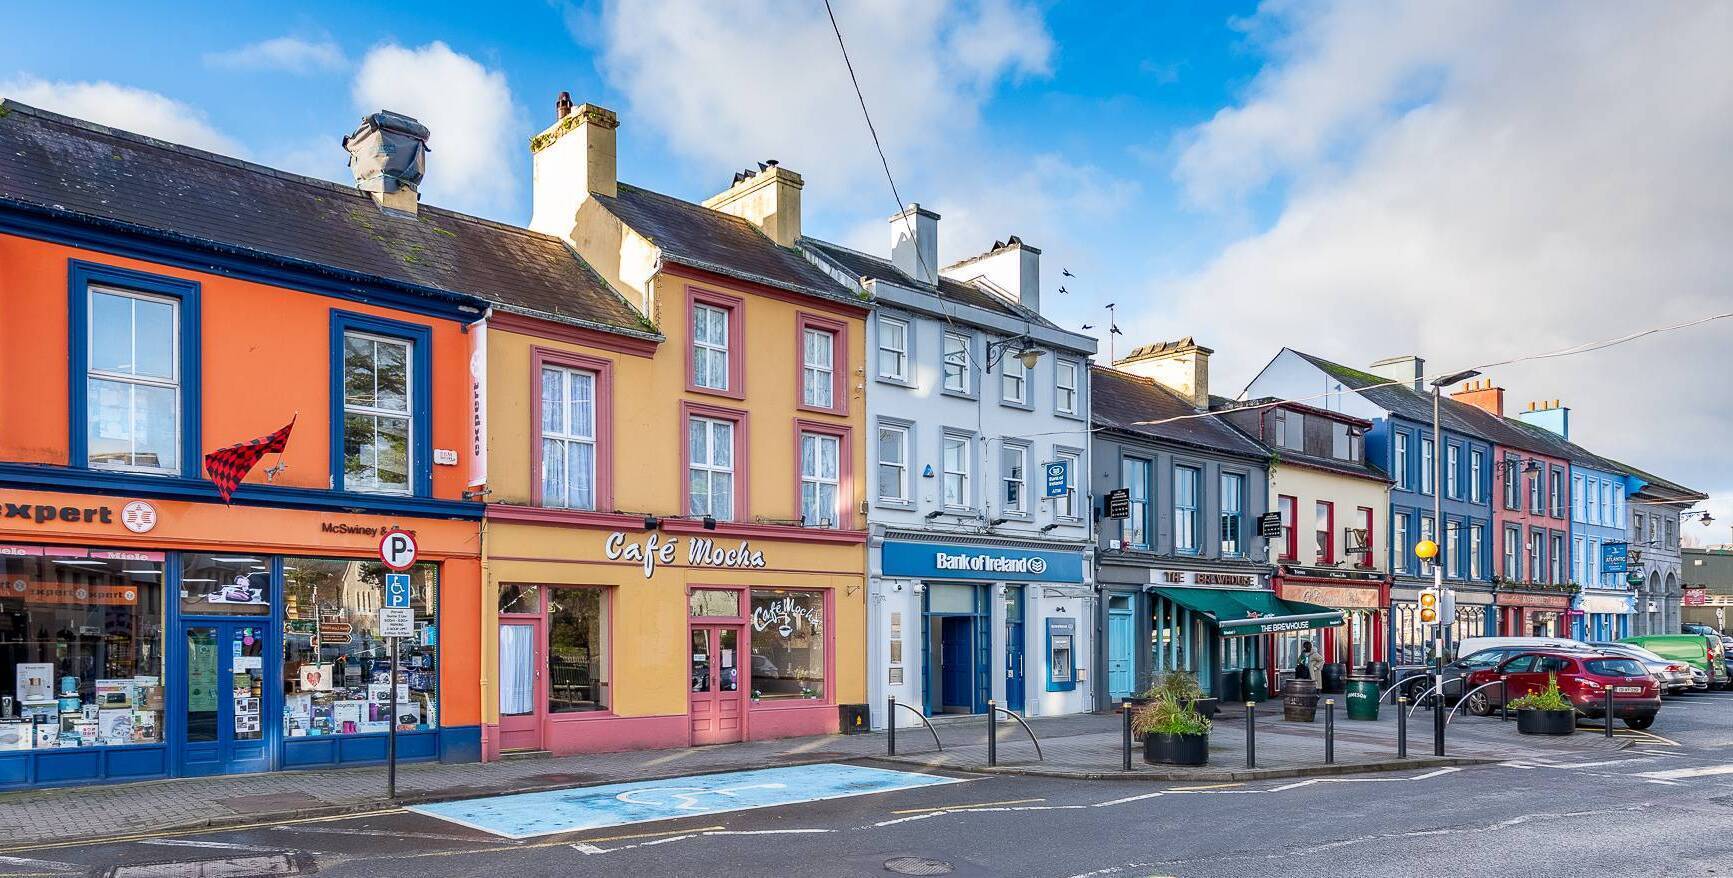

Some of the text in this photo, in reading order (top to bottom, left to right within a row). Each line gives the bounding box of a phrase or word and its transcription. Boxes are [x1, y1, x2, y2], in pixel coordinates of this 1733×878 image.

[0, 502, 113, 524] xpert
[321, 522, 378, 538] McSwiney
[0, 547, 26, 556] ele
[107, 552, 149, 561] Miele
[391, 537, 407, 562] P
[604, 531, 767, 579] Café Mocha
[936, 552, 1027, 572] Bank of Ireland
[1162, 571, 1184, 583] THE
[392, 595, 403, 607] P
[753, 601, 782, 632] Café
[1272, 620, 1310, 632] BREWHOUSE
